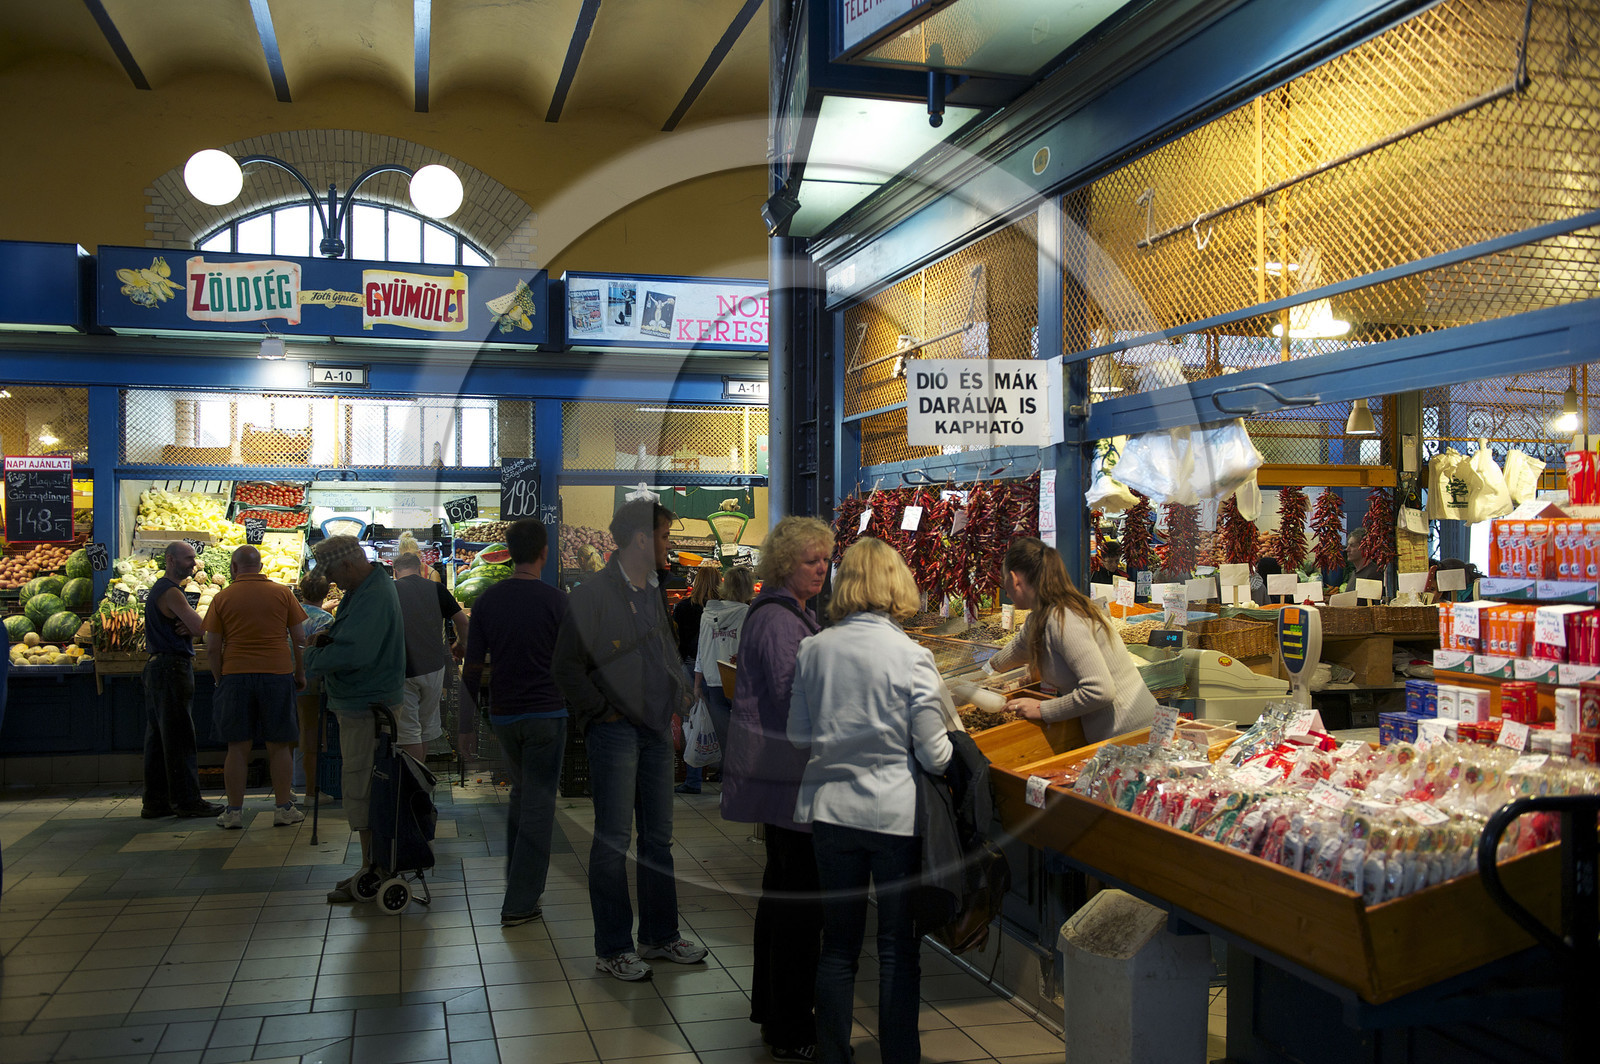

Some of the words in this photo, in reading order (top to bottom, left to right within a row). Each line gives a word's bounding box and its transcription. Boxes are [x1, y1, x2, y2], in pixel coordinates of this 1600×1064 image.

[190, 269, 292, 312] ZÖLDSÉG
[365, 278, 465, 323] GYÜMÖLCS
[332, 292, 359, 304] Gyula
[324, 370, 353, 382] A-10
[916, 368, 948, 390] DIÓ
[961, 368, 983, 390] ÉS
[995, 368, 1038, 390] MÁK
[738, 383, 761, 393] A-11
[919, 393, 1008, 414] DARÁLVA
[1019, 396, 1037, 414] IS
[935, 417, 1024, 435] KAPHATÓ
[7, 460, 27, 469] NAPI
[29, 459, 70, 468] AJÁNLAT!
